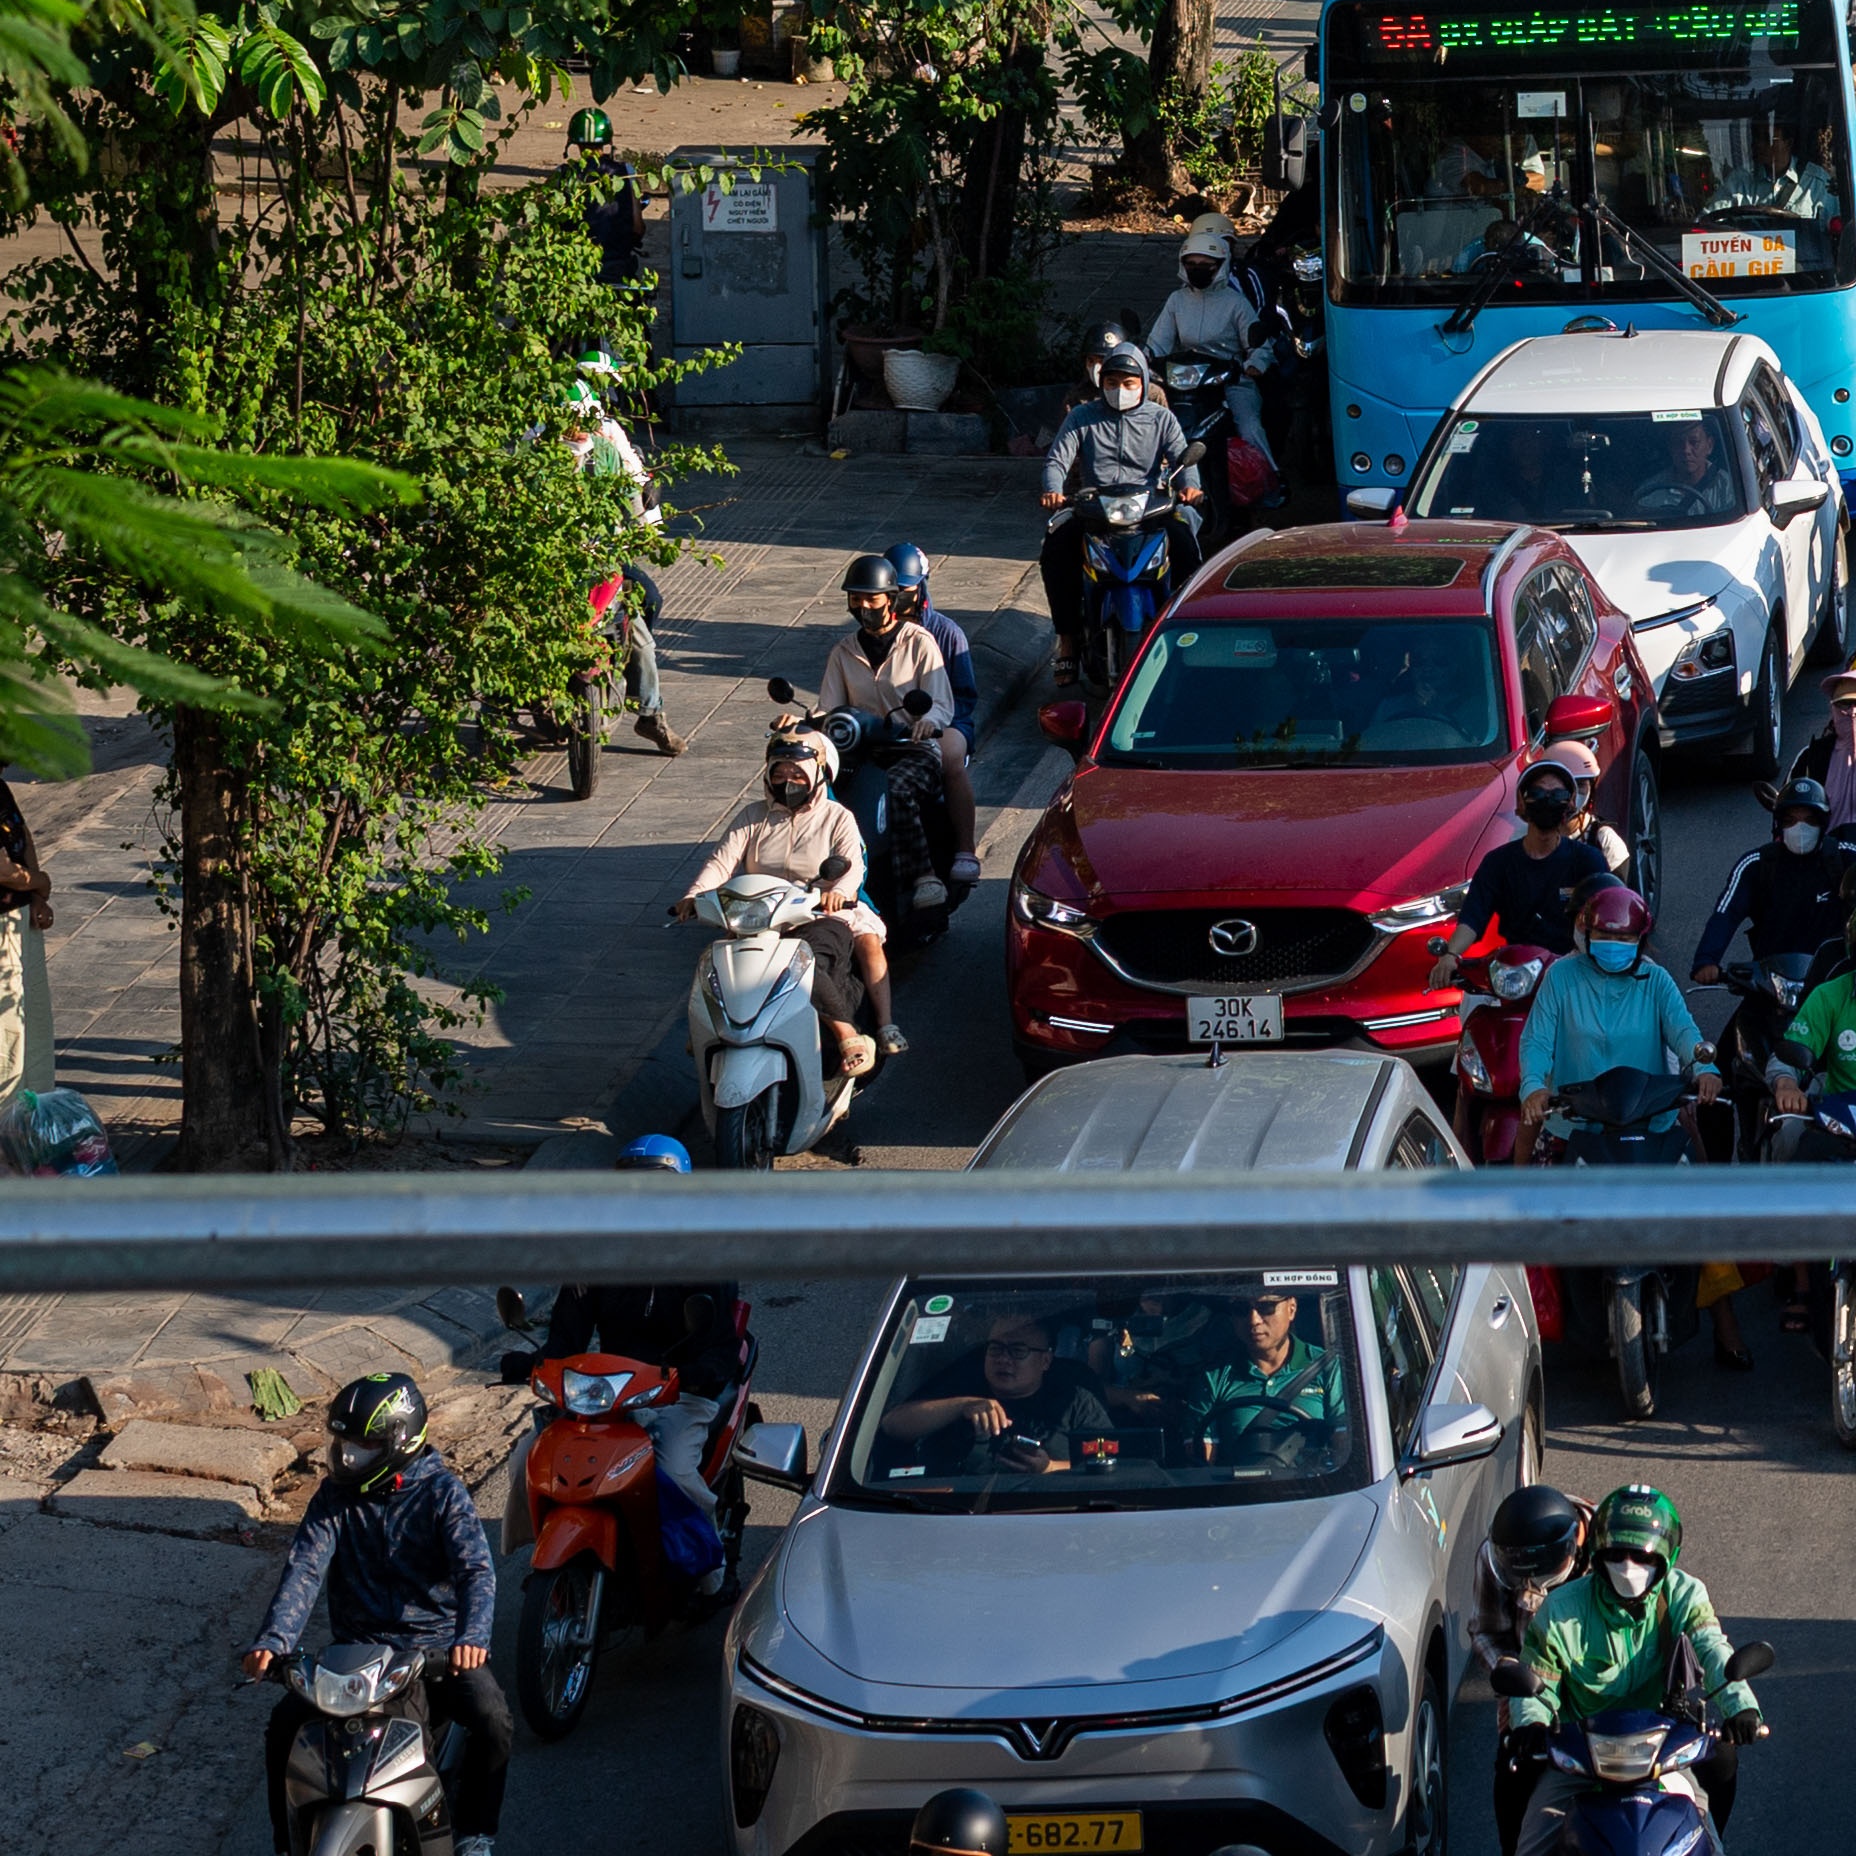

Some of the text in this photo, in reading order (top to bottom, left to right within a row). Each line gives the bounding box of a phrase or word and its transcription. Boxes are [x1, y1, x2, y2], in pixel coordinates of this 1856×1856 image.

[1700, 234, 1785, 255] TUYẾN 6A
[1690, 256, 1736, 279] CẦU
[1214, 998, 1255, 1019] 30K
[1199, 1019, 1274, 1042] 246.14
[1269, 1272, 1333, 1284] XE HỢP ĐỒNG
[1620, 1504, 1653, 1519] Grab
[1008, 1820, 1125, 1850] -682.77
